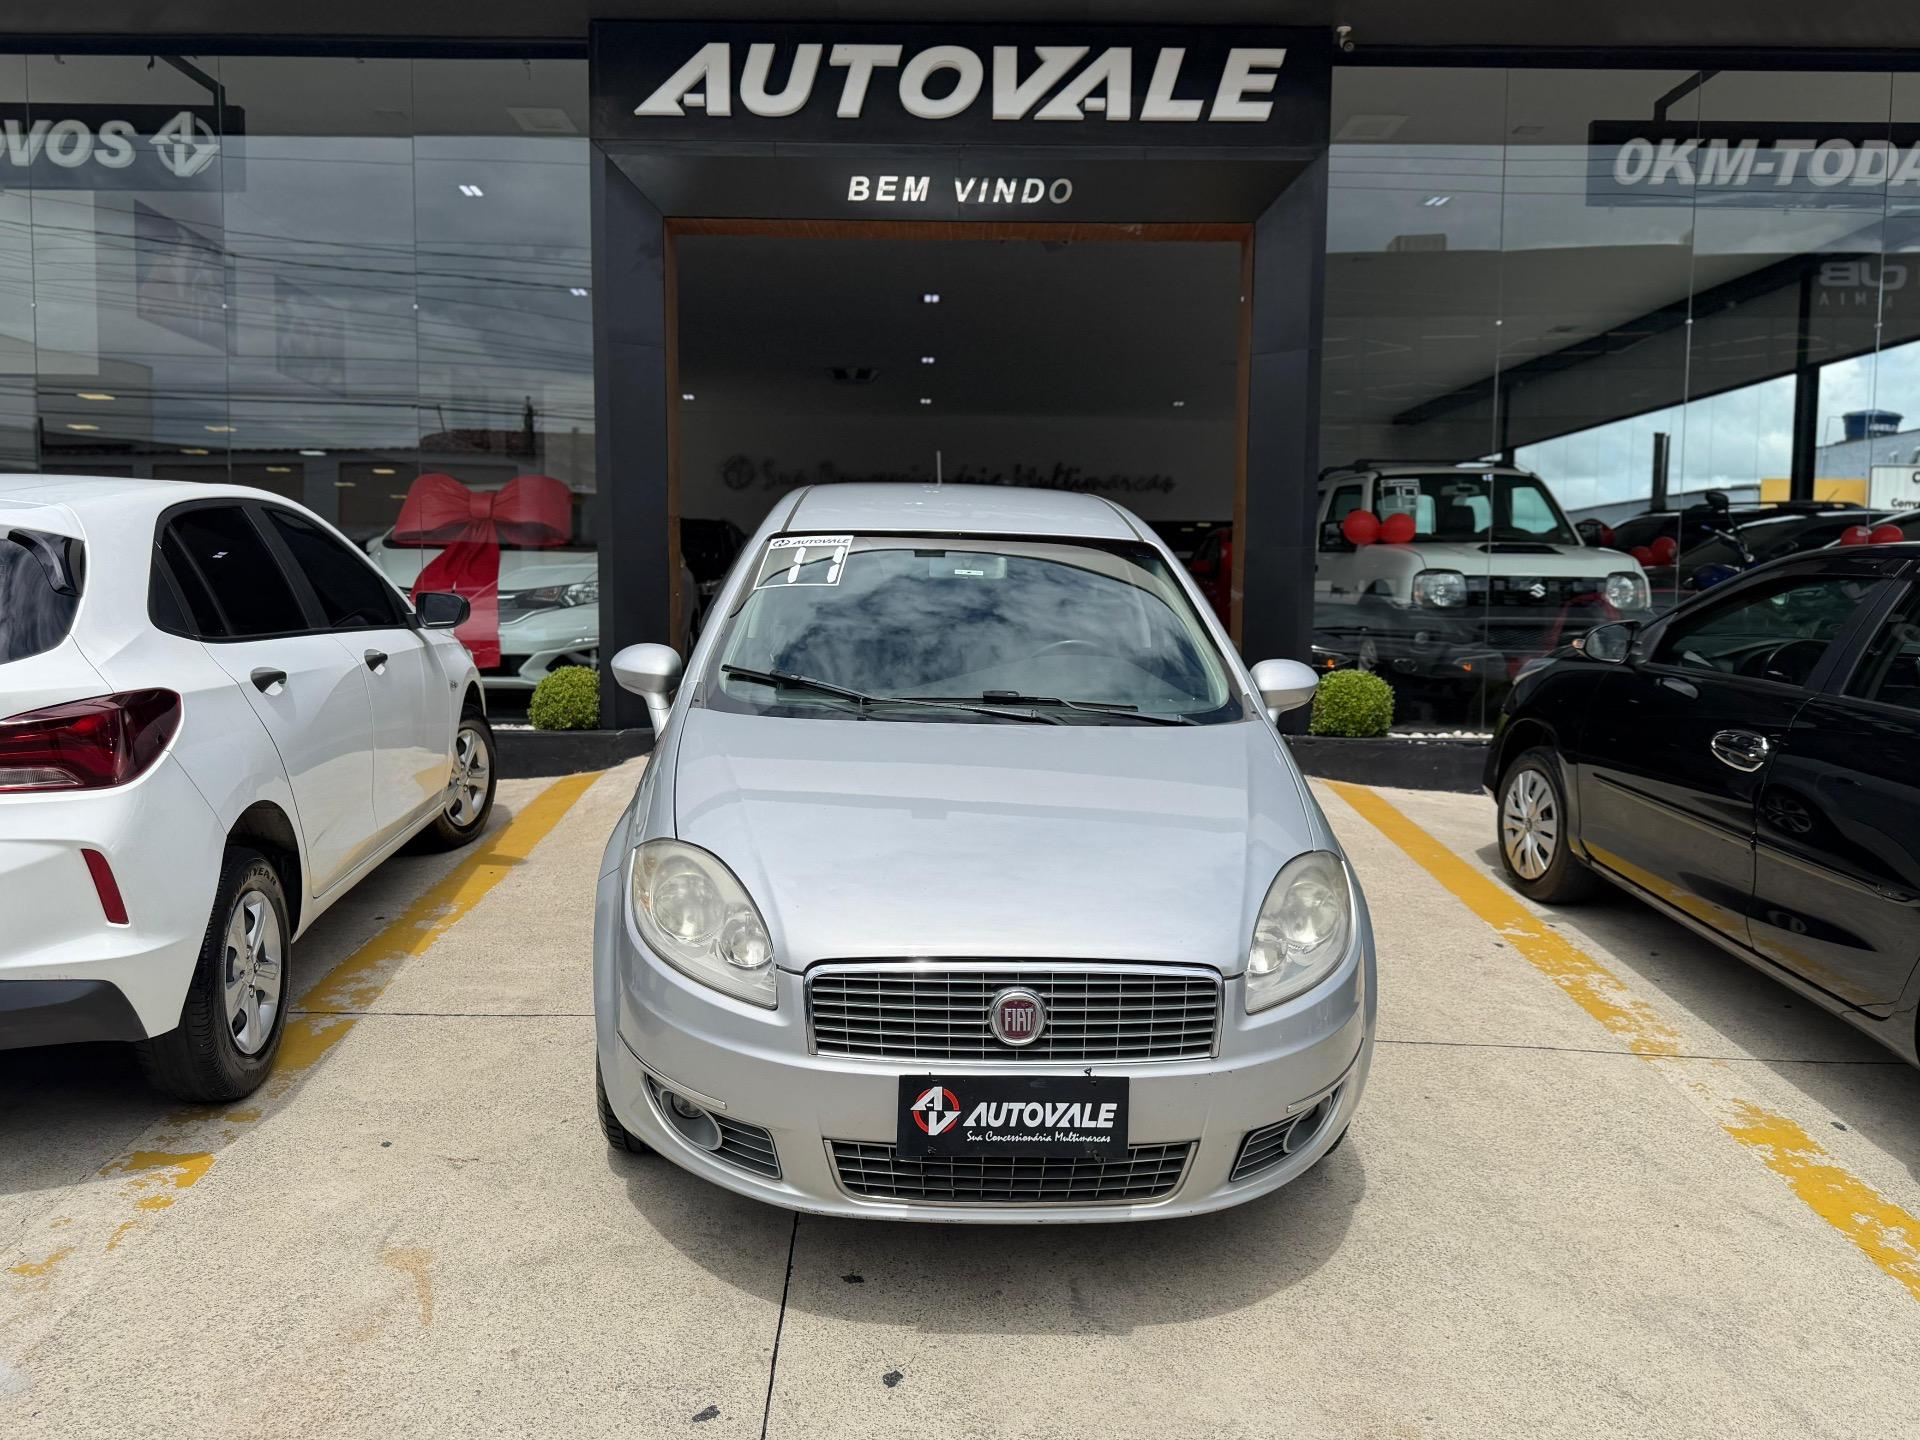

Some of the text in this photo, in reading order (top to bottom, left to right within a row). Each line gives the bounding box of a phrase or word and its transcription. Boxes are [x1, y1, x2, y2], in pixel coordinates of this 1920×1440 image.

[634, 42, 1287, 123] AUTOVALE
[0, 119, 137, 168] VOS
[847, 175, 1075, 204] BEM VINDO
[791, 537, 852, 546] AUTOVALE
[1004, 1008, 1034, 1032] FIAT
[962, 1101, 1118, 1128] AUTOVALE
[966, 1131, 1111, 1143] Sua Concessionária Multimarcas
